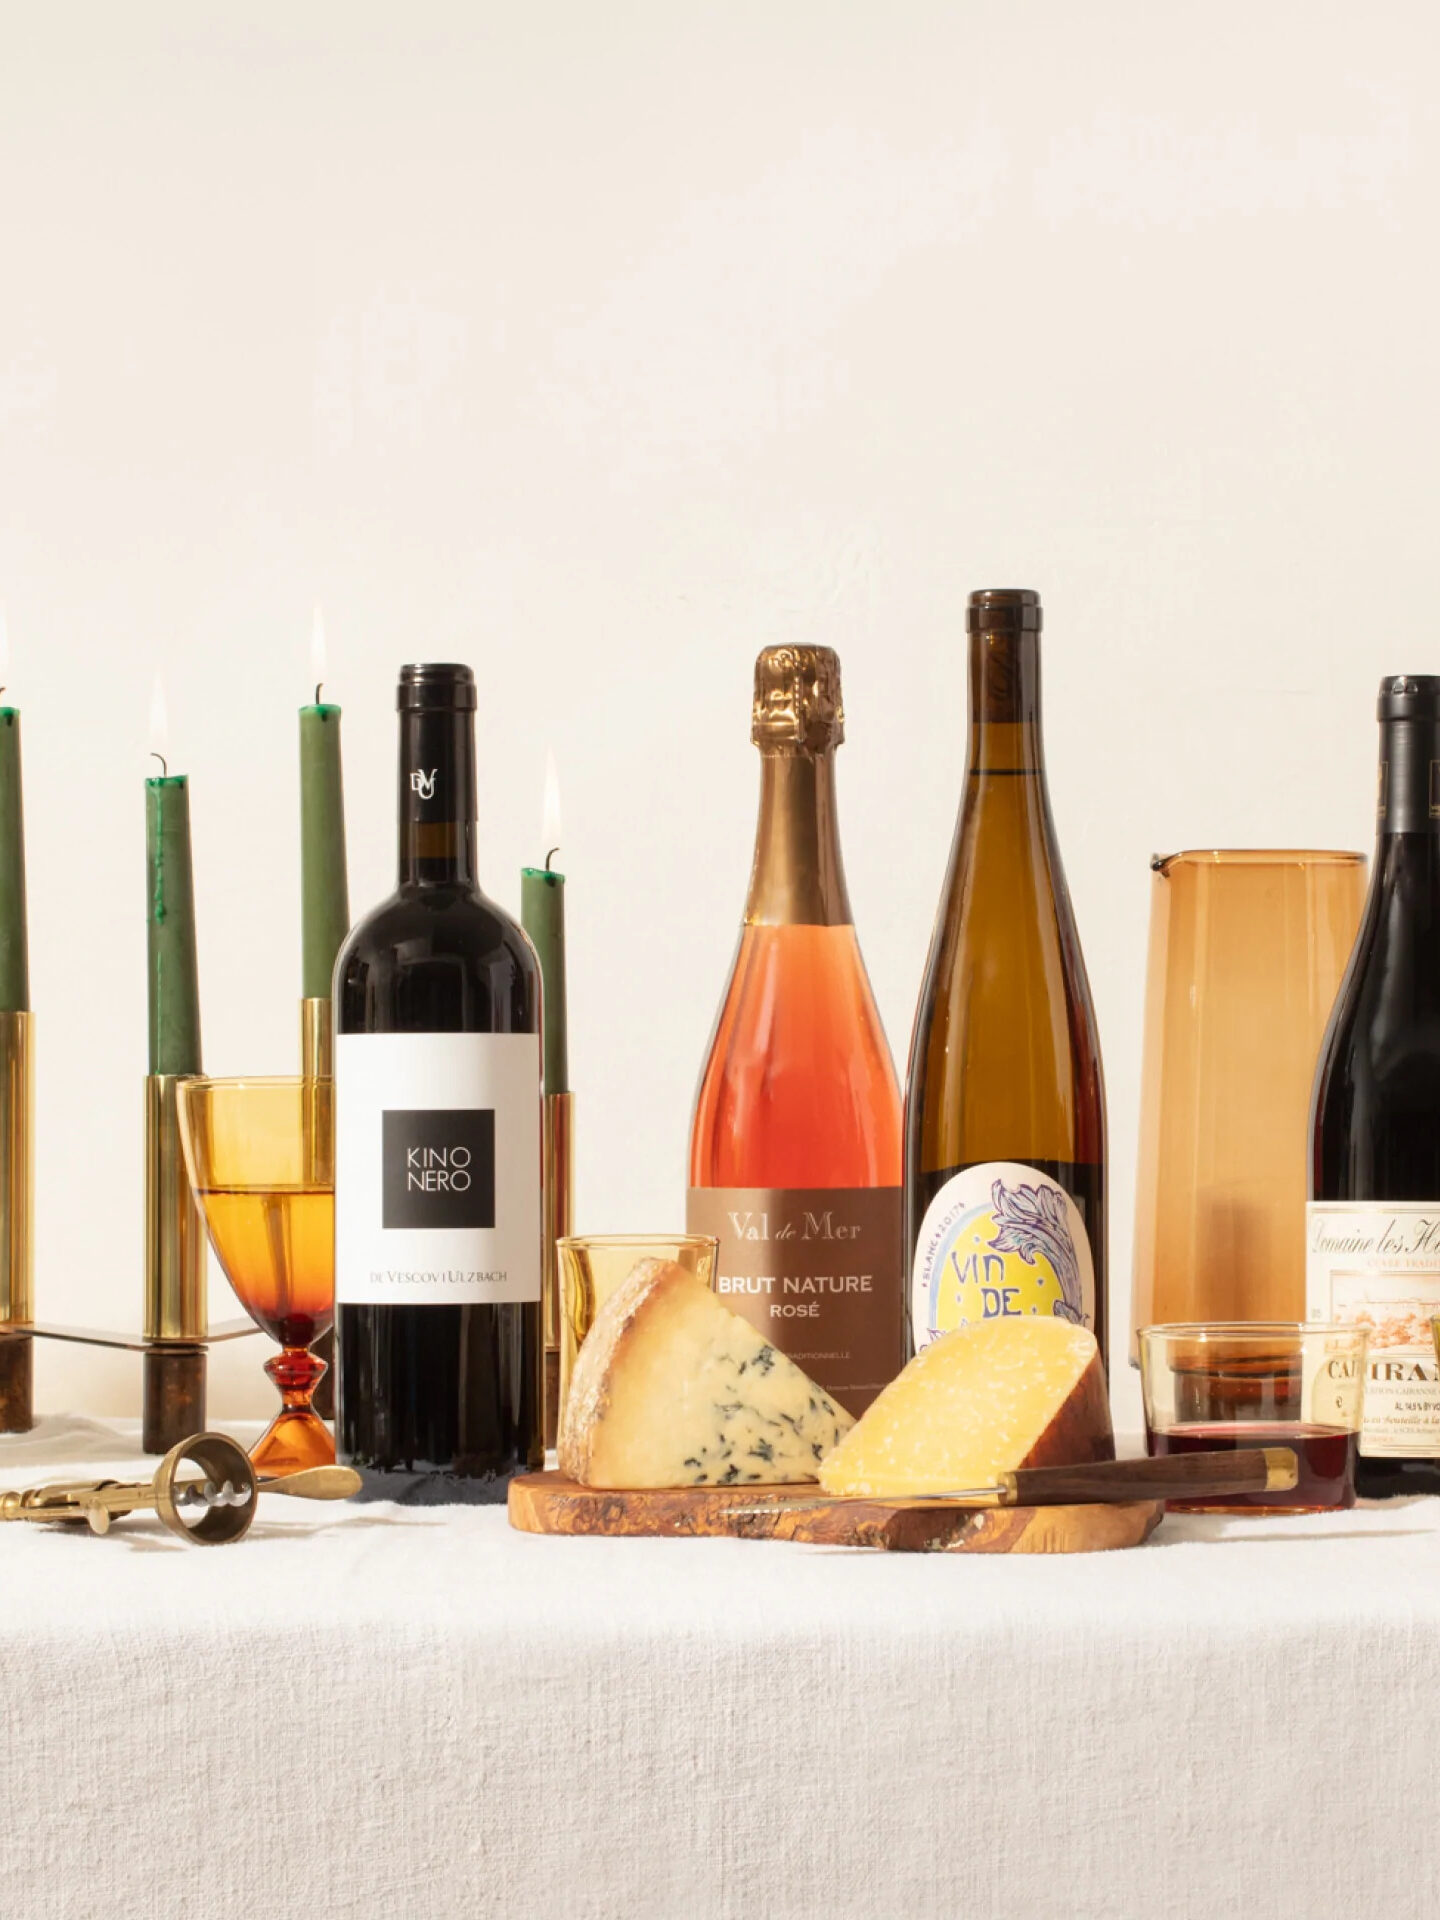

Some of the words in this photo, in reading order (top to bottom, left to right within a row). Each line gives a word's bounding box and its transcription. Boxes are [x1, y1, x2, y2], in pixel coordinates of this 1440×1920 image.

[407, 1146, 471, 1168] KINO
[408, 1170, 471, 1191] NERO
[728, 1212, 769, 1241] Val
[775, 1222, 797, 1240] de
[802, 1211, 863, 1241] Mer
[1312, 1218, 1375, 1254] Domaine
[923, 1240, 938, 1280] BLANC
[938, 1203, 961, 1233] 2017
[718, 1276, 776, 1294] BRUT
[783, 1275, 873, 1294] NATURE
[770, 1301, 820, 1318] ROSÉ
[981, 1288, 1022, 1318] DE
